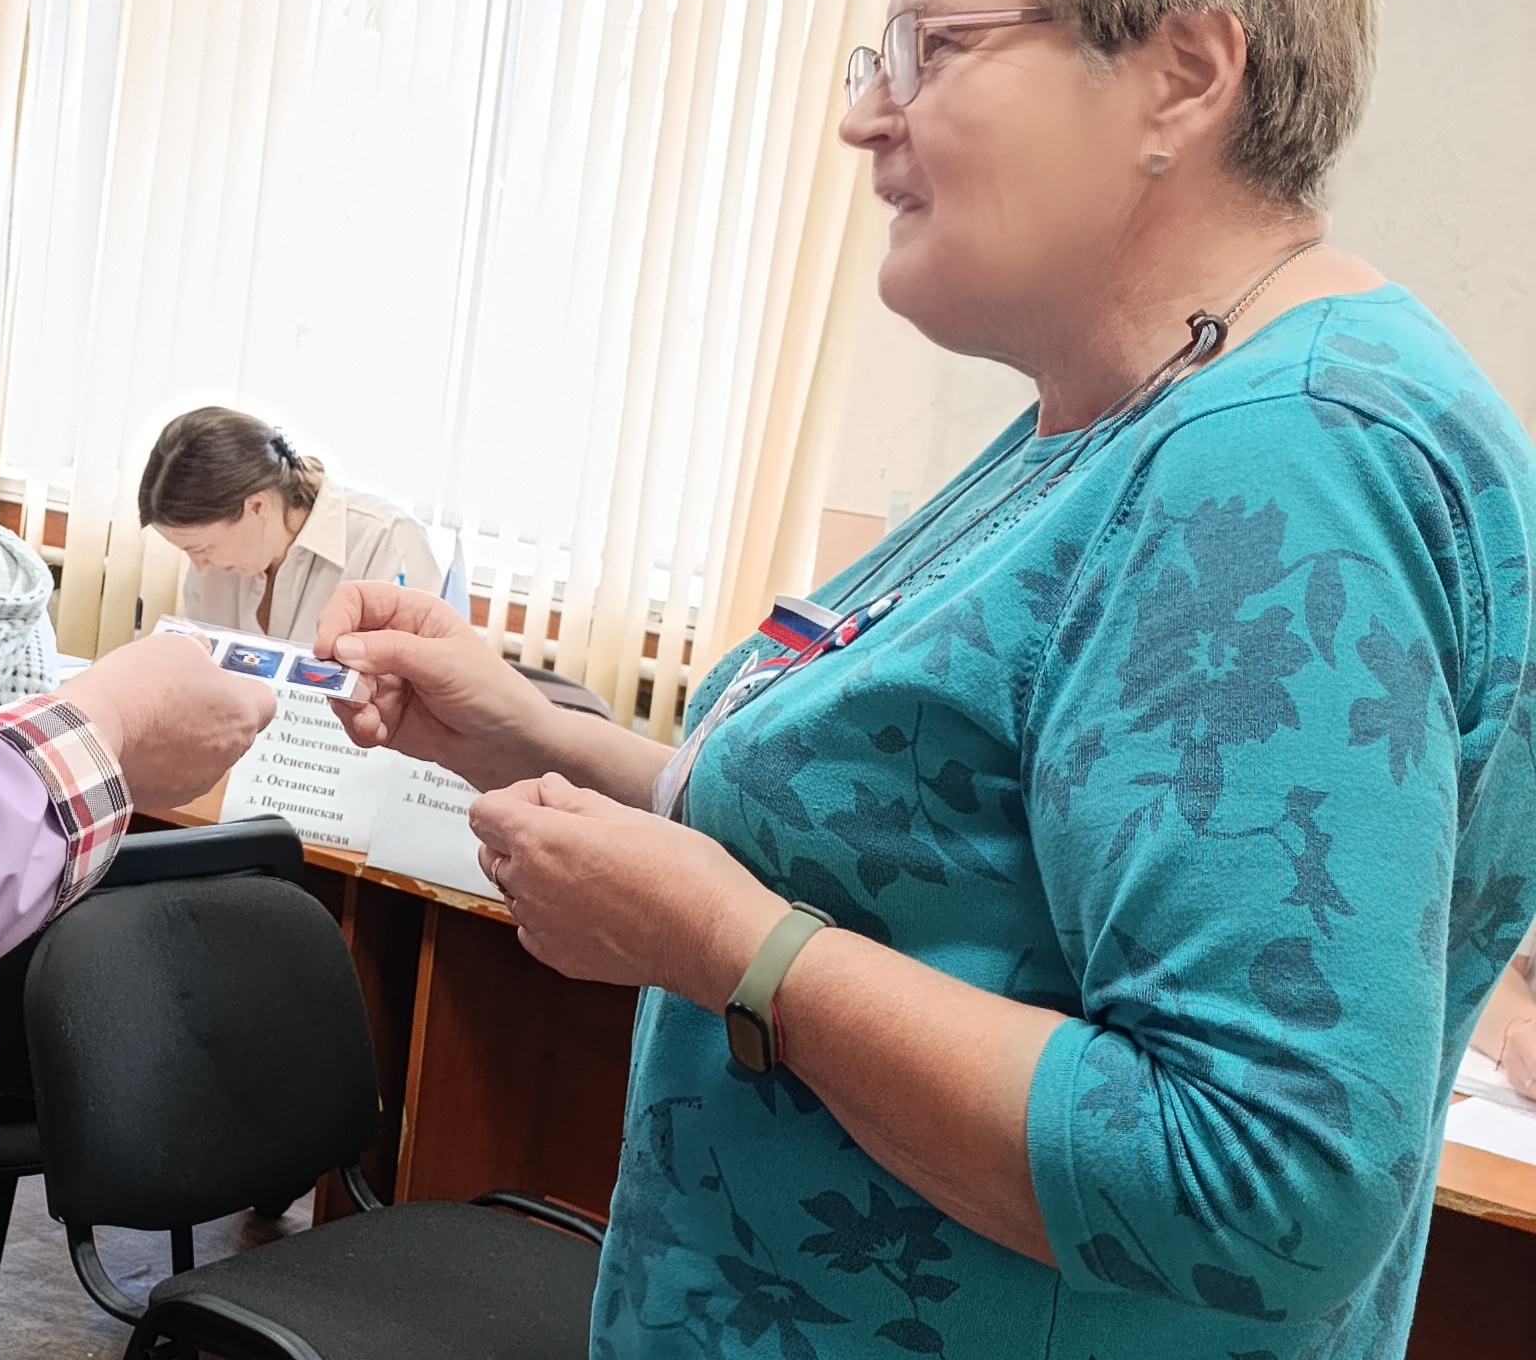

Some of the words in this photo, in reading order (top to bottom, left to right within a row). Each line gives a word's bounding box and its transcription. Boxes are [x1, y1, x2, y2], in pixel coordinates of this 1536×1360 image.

[289, 688, 330, 707] Копы
[278, 730, 370, 759] Модестовская
[266, 772, 336, 798] Останская
[260, 794, 345, 822] Першинская
